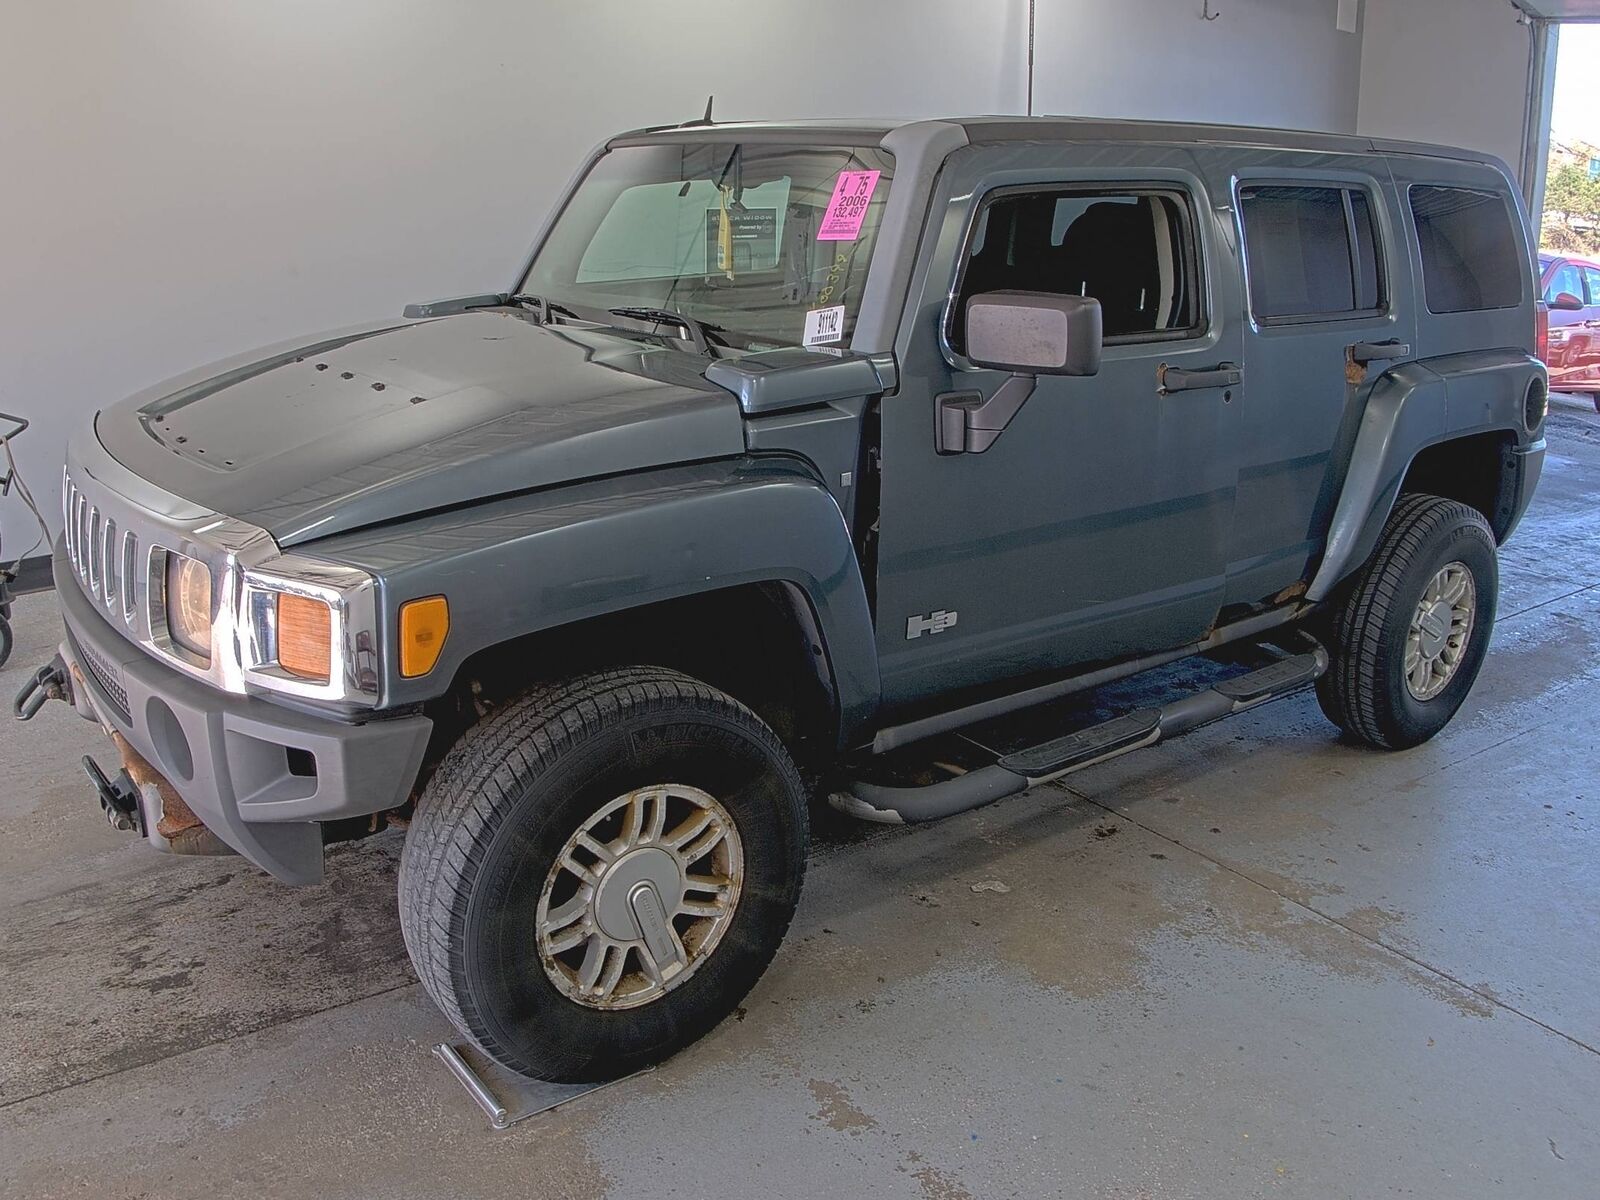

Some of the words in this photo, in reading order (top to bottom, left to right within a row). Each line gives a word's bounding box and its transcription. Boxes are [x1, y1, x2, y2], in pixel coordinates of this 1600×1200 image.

[839, 176, 849, 196] 4
[854, 176, 870, 196] 75
[838, 195, 868, 207] 2006
[833, 207, 865, 219] 132,497
[818, 311, 839, 334] 911142
[906, 610, 958, 640] H3
